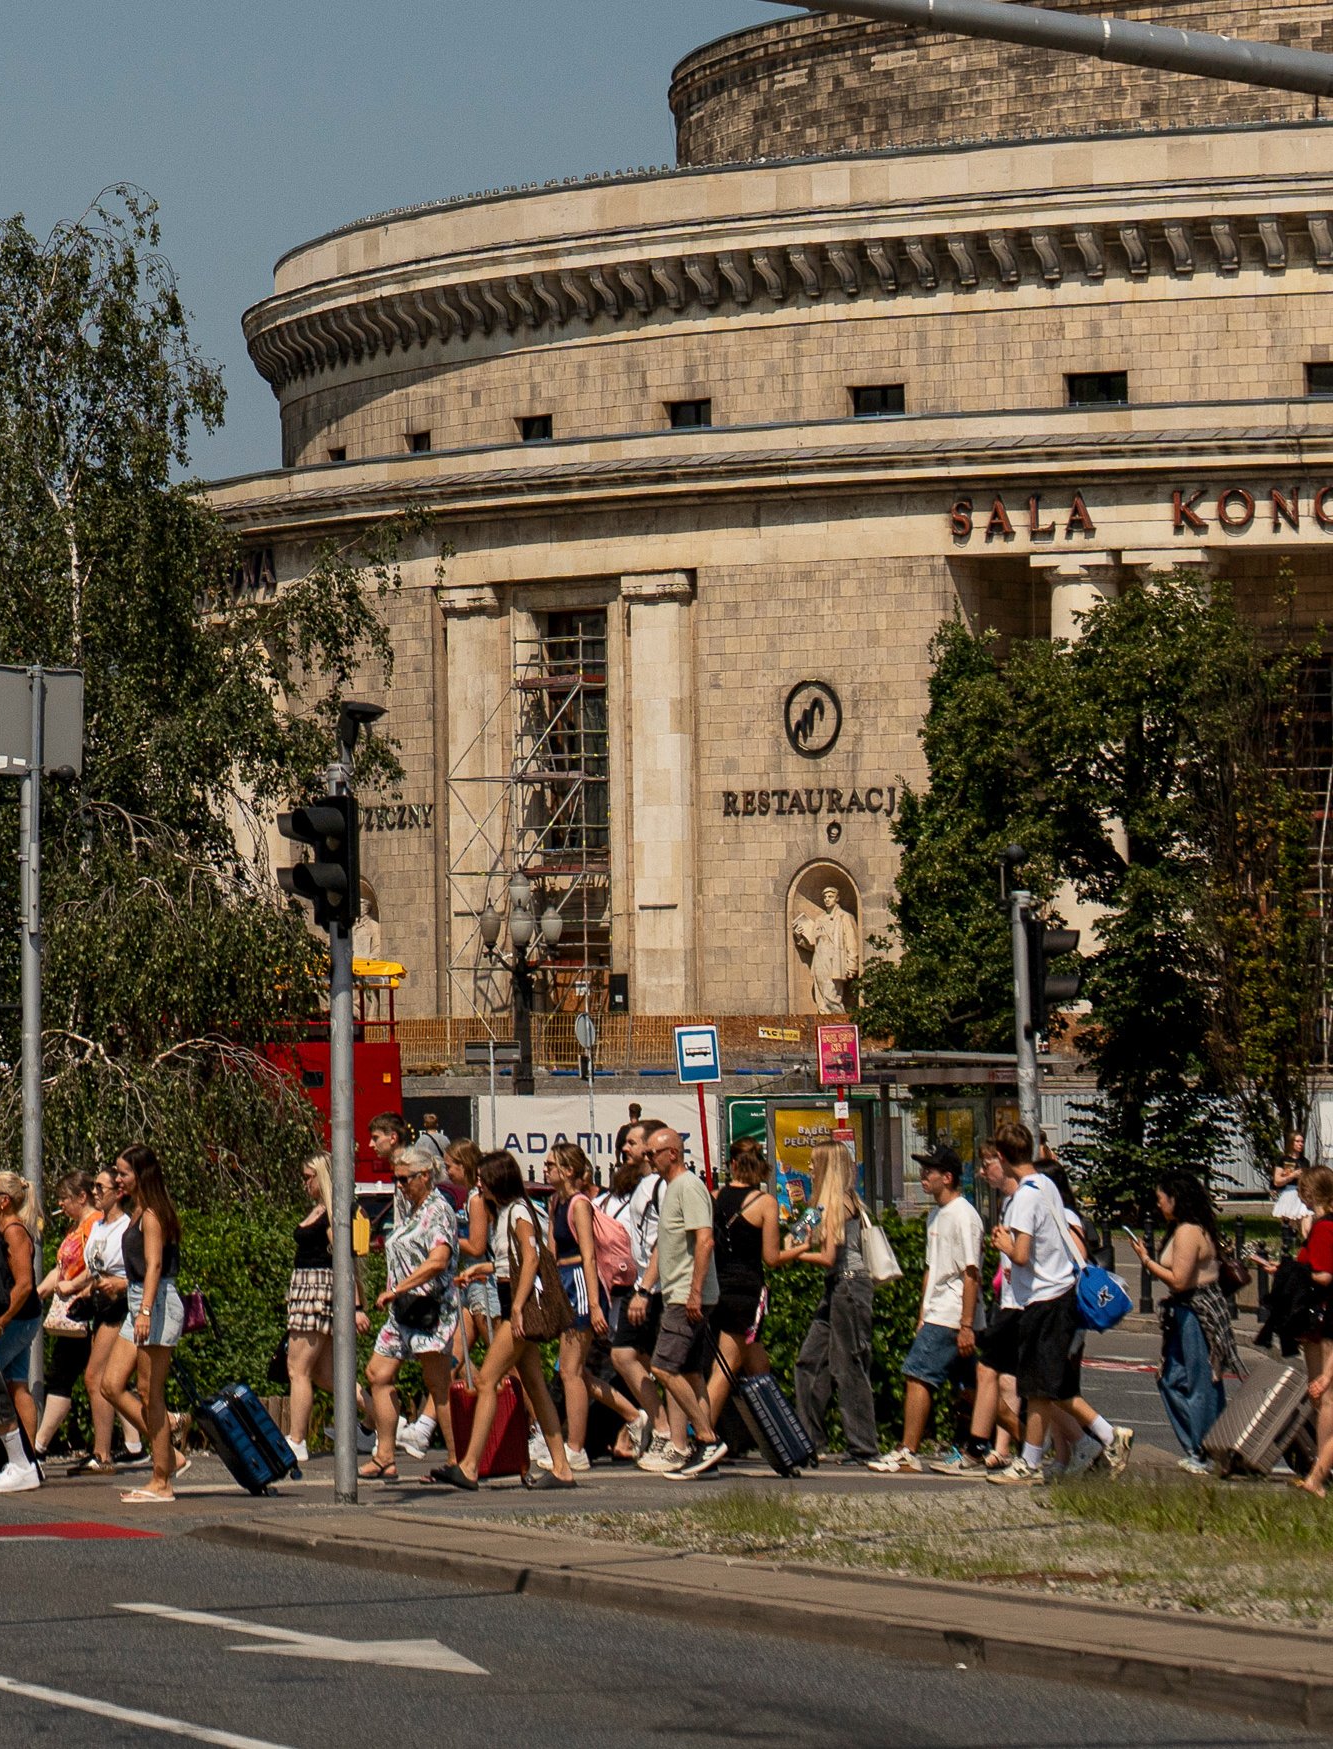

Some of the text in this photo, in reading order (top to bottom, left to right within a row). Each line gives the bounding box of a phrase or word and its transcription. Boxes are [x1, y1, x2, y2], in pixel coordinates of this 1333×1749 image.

[951, 488, 1097, 536] SALA
[722, 786, 900, 818] RESTAURACJ
[503, 1132, 692, 1155] ADAMIZ
